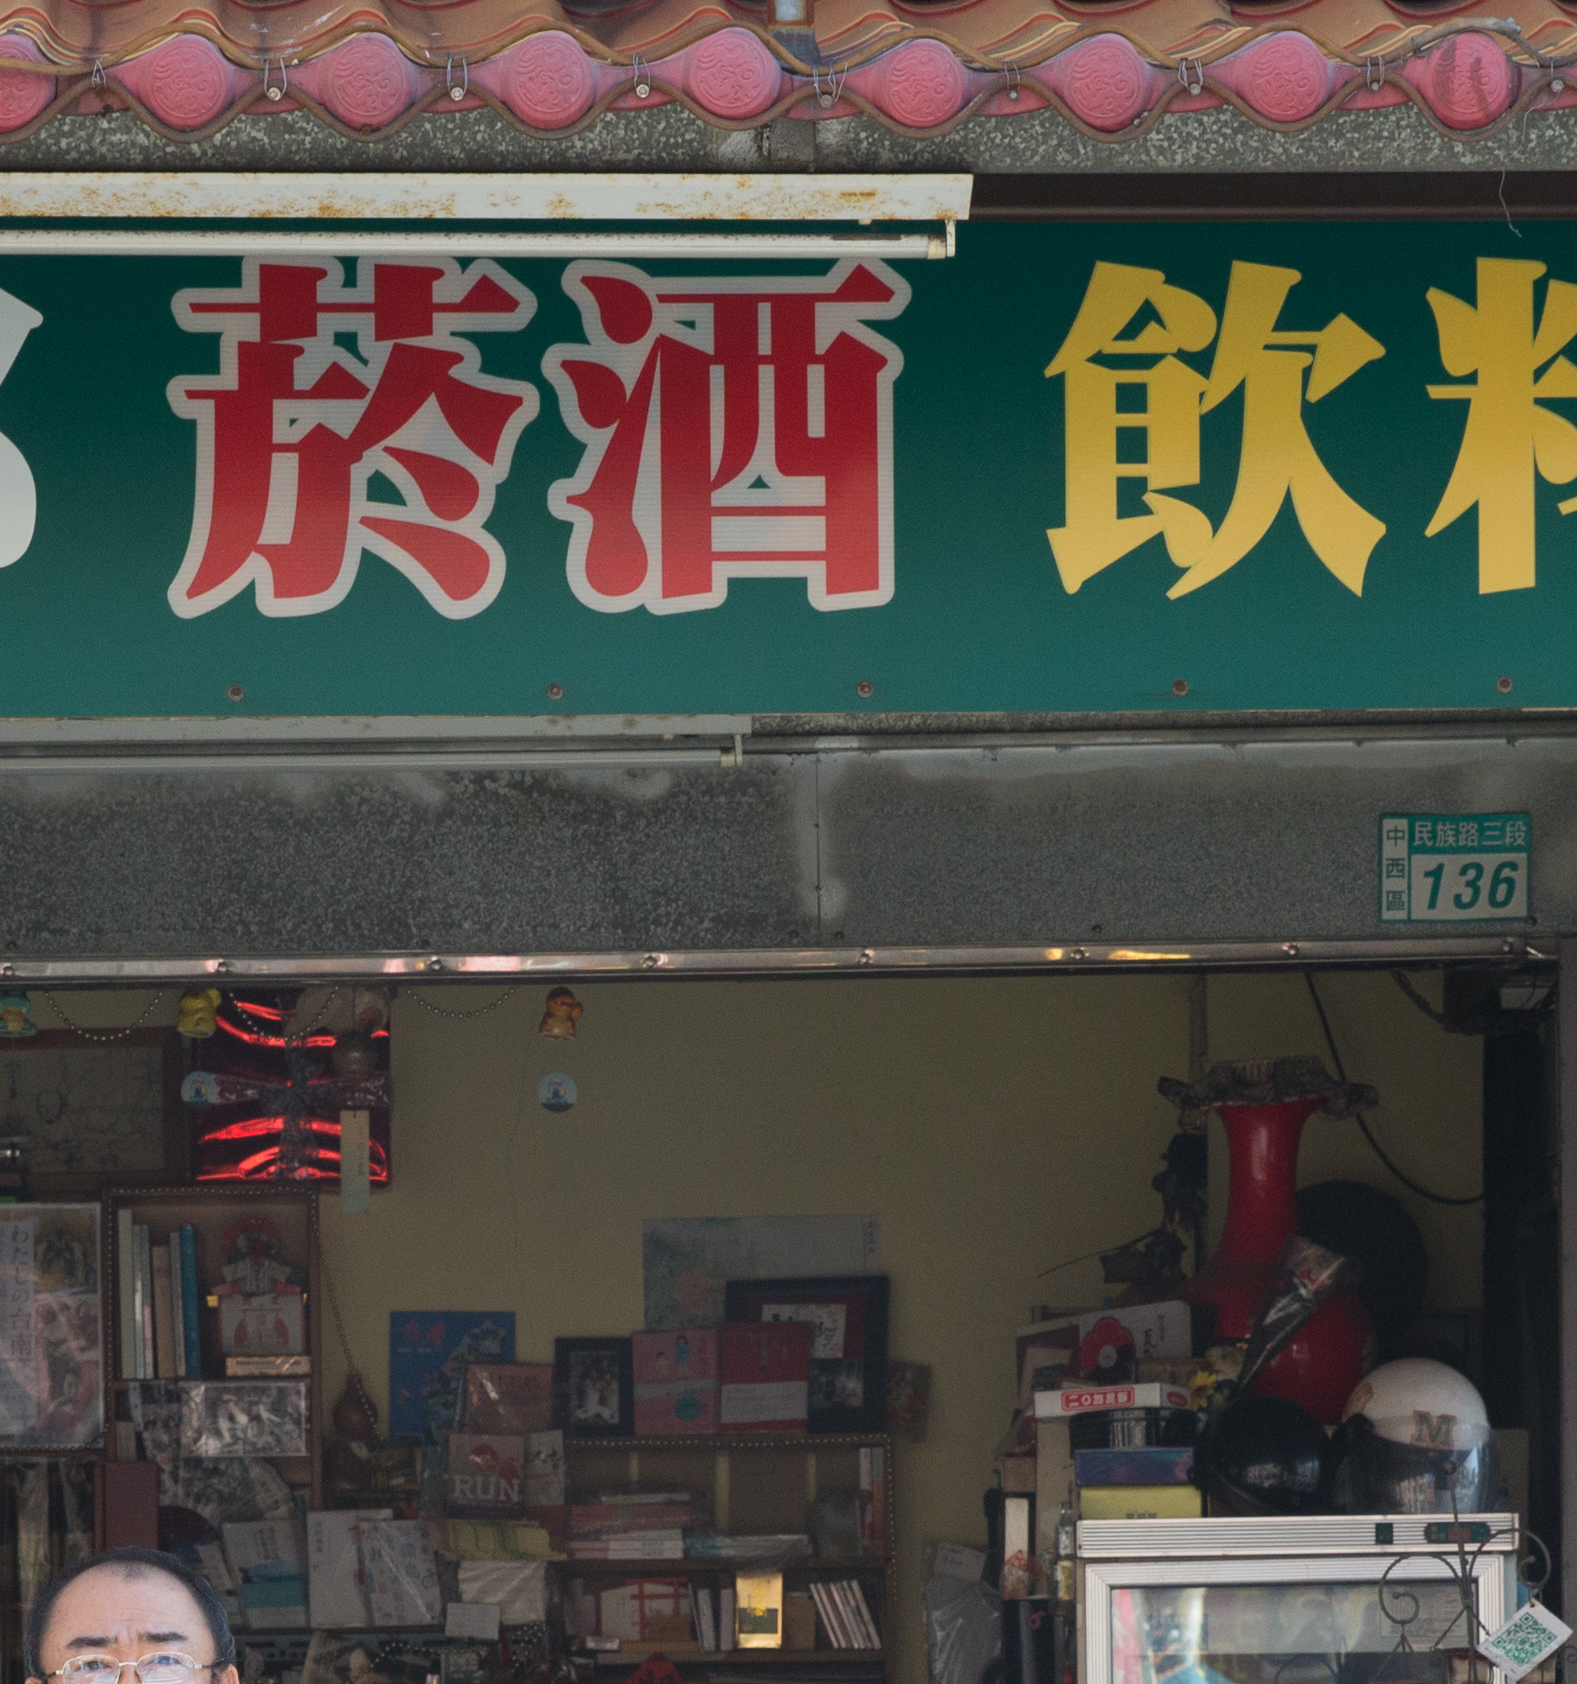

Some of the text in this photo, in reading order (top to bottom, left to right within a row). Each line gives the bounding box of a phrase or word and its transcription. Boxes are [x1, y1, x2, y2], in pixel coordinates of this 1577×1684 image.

[165, 257, 911, 620] 菸酒
[1413, 820, 1527, 847] 民族路三段
[1385, 826, 1406, 912] 中西區
[1423, 861, 1520, 910] 136
[452, 1475, 522, 1502] RUN
